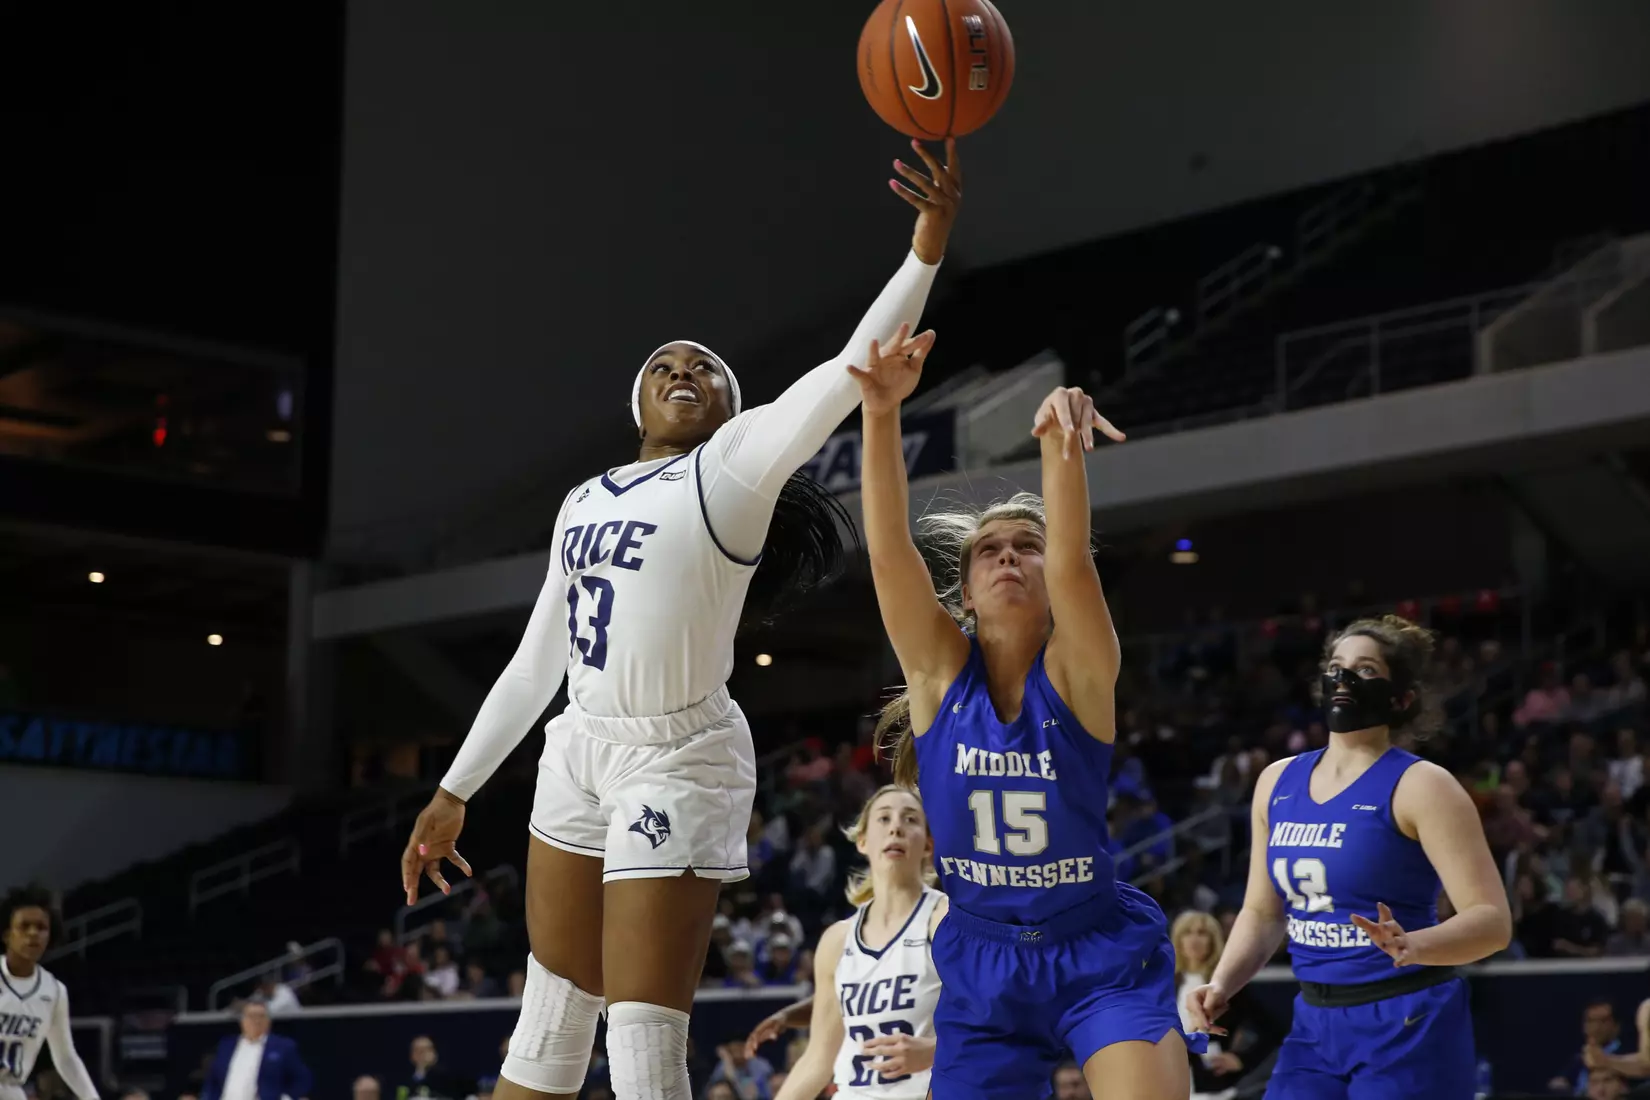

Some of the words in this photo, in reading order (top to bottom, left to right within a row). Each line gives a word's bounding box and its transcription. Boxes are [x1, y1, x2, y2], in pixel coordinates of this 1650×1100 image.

[561, 520, 658, 576] RICE
[567, 575, 615, 672] 13
[954, 743, 1057, 781] MIDDLE
[967, 789, 1050, 856] 15
[1269, 821, 1347, 848] MIDDLE
[940, 856, 1094, 888] TENNESSEE
[1273, 857, 1335, 913] 12
[841, 974, 918, 1017] RICE
